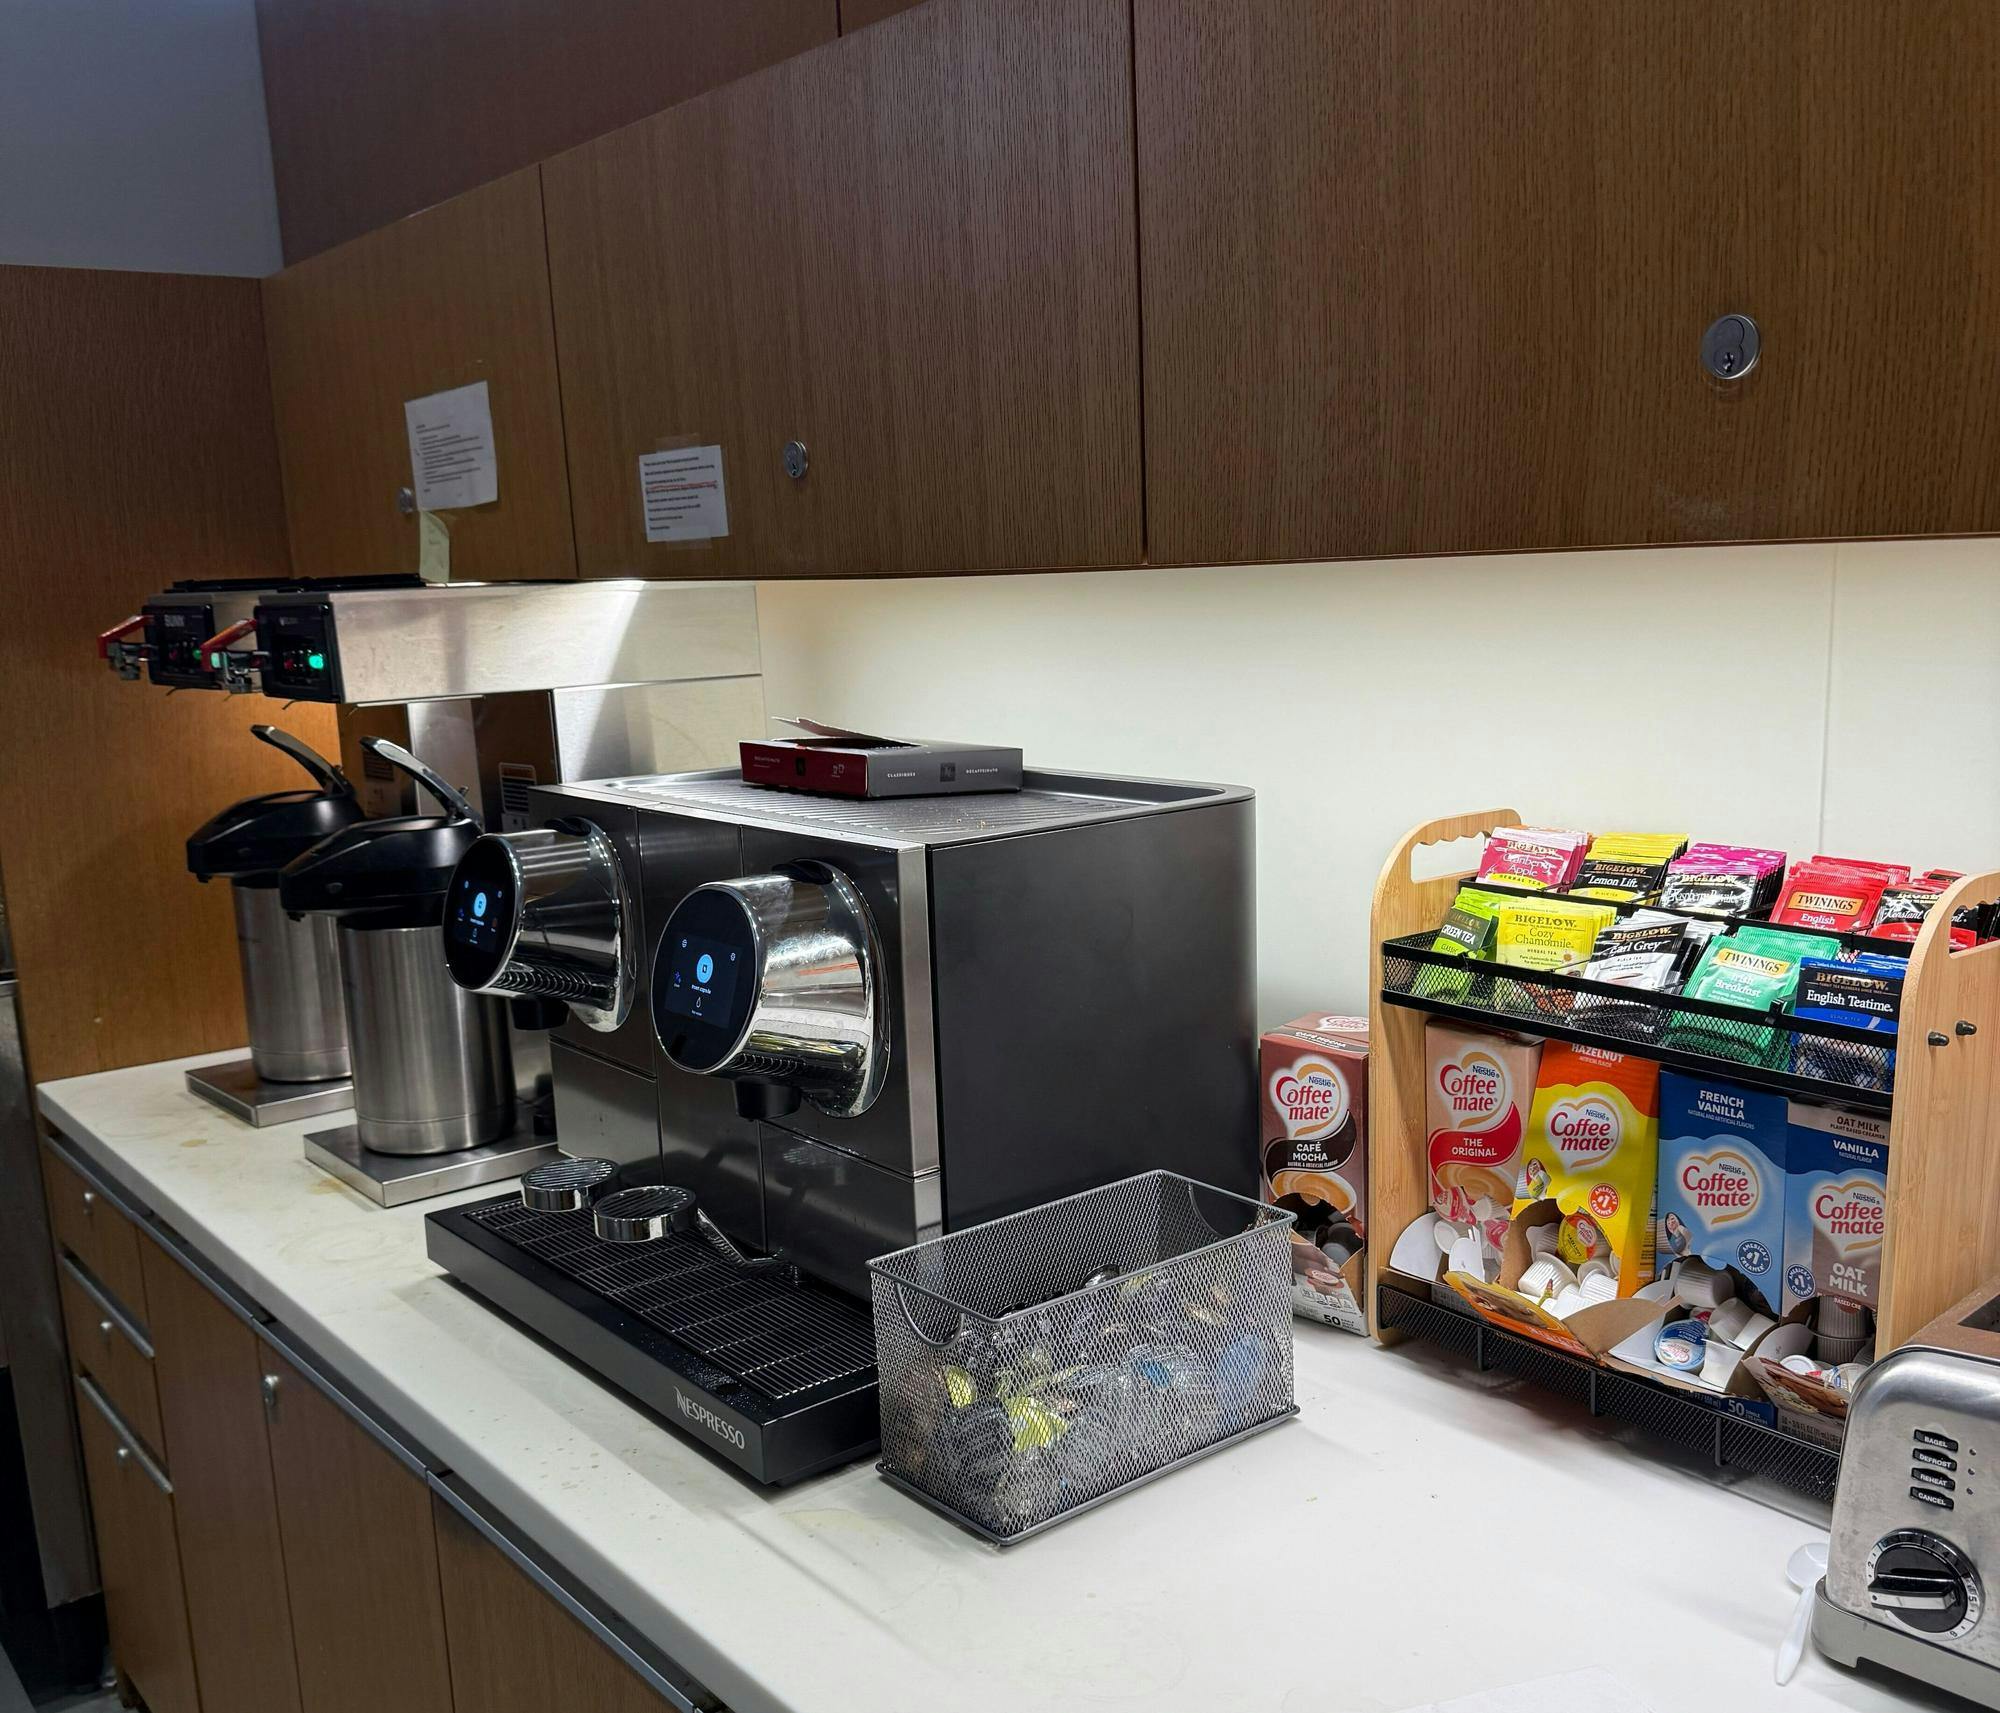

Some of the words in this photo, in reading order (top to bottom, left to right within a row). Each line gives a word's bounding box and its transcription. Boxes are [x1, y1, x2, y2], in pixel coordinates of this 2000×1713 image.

[1510, 864, 1538, 878] Apple
[1593, 863, 1645, 874] BIGELOW
[1588, 875, 1619, 886] Lemon
[1620, 877, 1638, 888] Lift
[1798, 894, 1854, 911] TWININGS
[1515, 914, 1575, 928] BIGELOW
[1801, 913, 1836, 924] English
[1442, 924, 1462, 939] GREEN
[1461, 930, 1476, 945] TEA
[1515, 933, 1572, 948] Chamomile
[1530, 927, 1555, 938] Cozy
[1612, 926, 1671, 939] BIGELOW
[1609, 941, 1632, 957] Earl
[1634, 940, 1662, 953] Grey
[1724, 951, 1781, 973] TWININGS
[1715, 980, 1761, 998] Breakfast
[1816, 972, 1885, 990] BIGELOW
[1806, 989, 1845, 1006] English
[1848, 995, 1890, 1012] Teatime
[1571, 1043, 1624, 1063] HAZELNUT
[1473, 1065, 1496, 1078] Nestlé
[1440, 1064, 1496, 1096] Coffee
[1276, 1076, 1332, 1107] Coffee
[1700, 1089, 1744, 1109] FRENCH
[1453, 1096, 1493, 1111] mate
[1697, 1101, 1745, 1120] VANILLA
[1288, 1106, 1329, 1120] mate
[1550, 1111, 1611, 1136] Coffee
[1837, 1115, 1855, 1128] OAT
[1857, 1120, 1880, 1133] MILK
[1296, 1141, 1322, 1152] CAFÉ
[1463, 1137, 1483, 1147] THE
[1560, 1136, 1610, 1151] mate
[1833, 1139, 1879, 1159] VANILLA
[1292, 1152, 1328, 1162] MOCHA
[1451, 1147, 1497, 1157] ORIGINAL
[1682, 1165, 1749, 1191] Coffee
[1697, 1190, 1751, 1206] mate
[1815, 1194, 1882, 1220] Coffee
[1830, 1218, 1884, 1234] mate
[1742, 1242, 1769, 1261] AMERICA'S
[1832, 1262, 1866, 1282] OAT
[1829, 1274, 1868, 1297] MILK
[1324, 1314, 1341, 1326] 50
[1727, 1399, 1745, 1418] 50
[673, 1385, 745, 1450] NESPRESSO
[1924, 1435, 1948, 1448] BAGEL
[1920, 1453, 1952, 1468] DEFROST
[1920, 1473, 1947, 1486] REHEAT
[1918, 1492, 1946, 1506] CANCEL
[1968, 1595, 1977, 1604] 5
